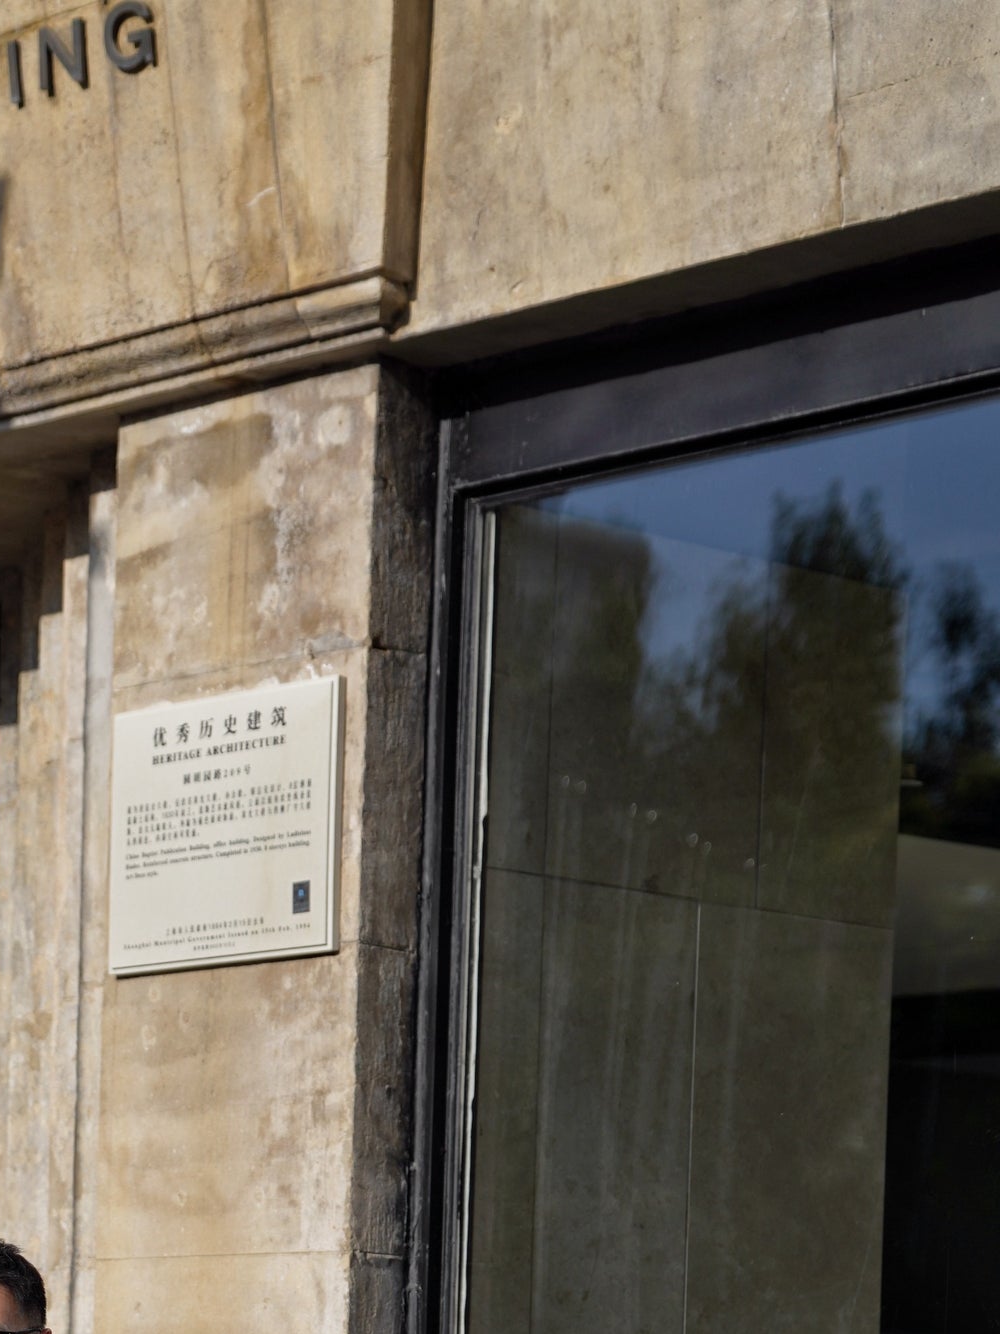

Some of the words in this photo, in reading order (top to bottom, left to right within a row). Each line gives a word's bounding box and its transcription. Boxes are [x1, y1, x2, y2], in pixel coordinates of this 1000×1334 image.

[153, 705, 288, 748] 优秀历史建筑
[152, 748, 203, 766] HERITAGE
[206, 734, 287, 757] ARCHITECTURE
